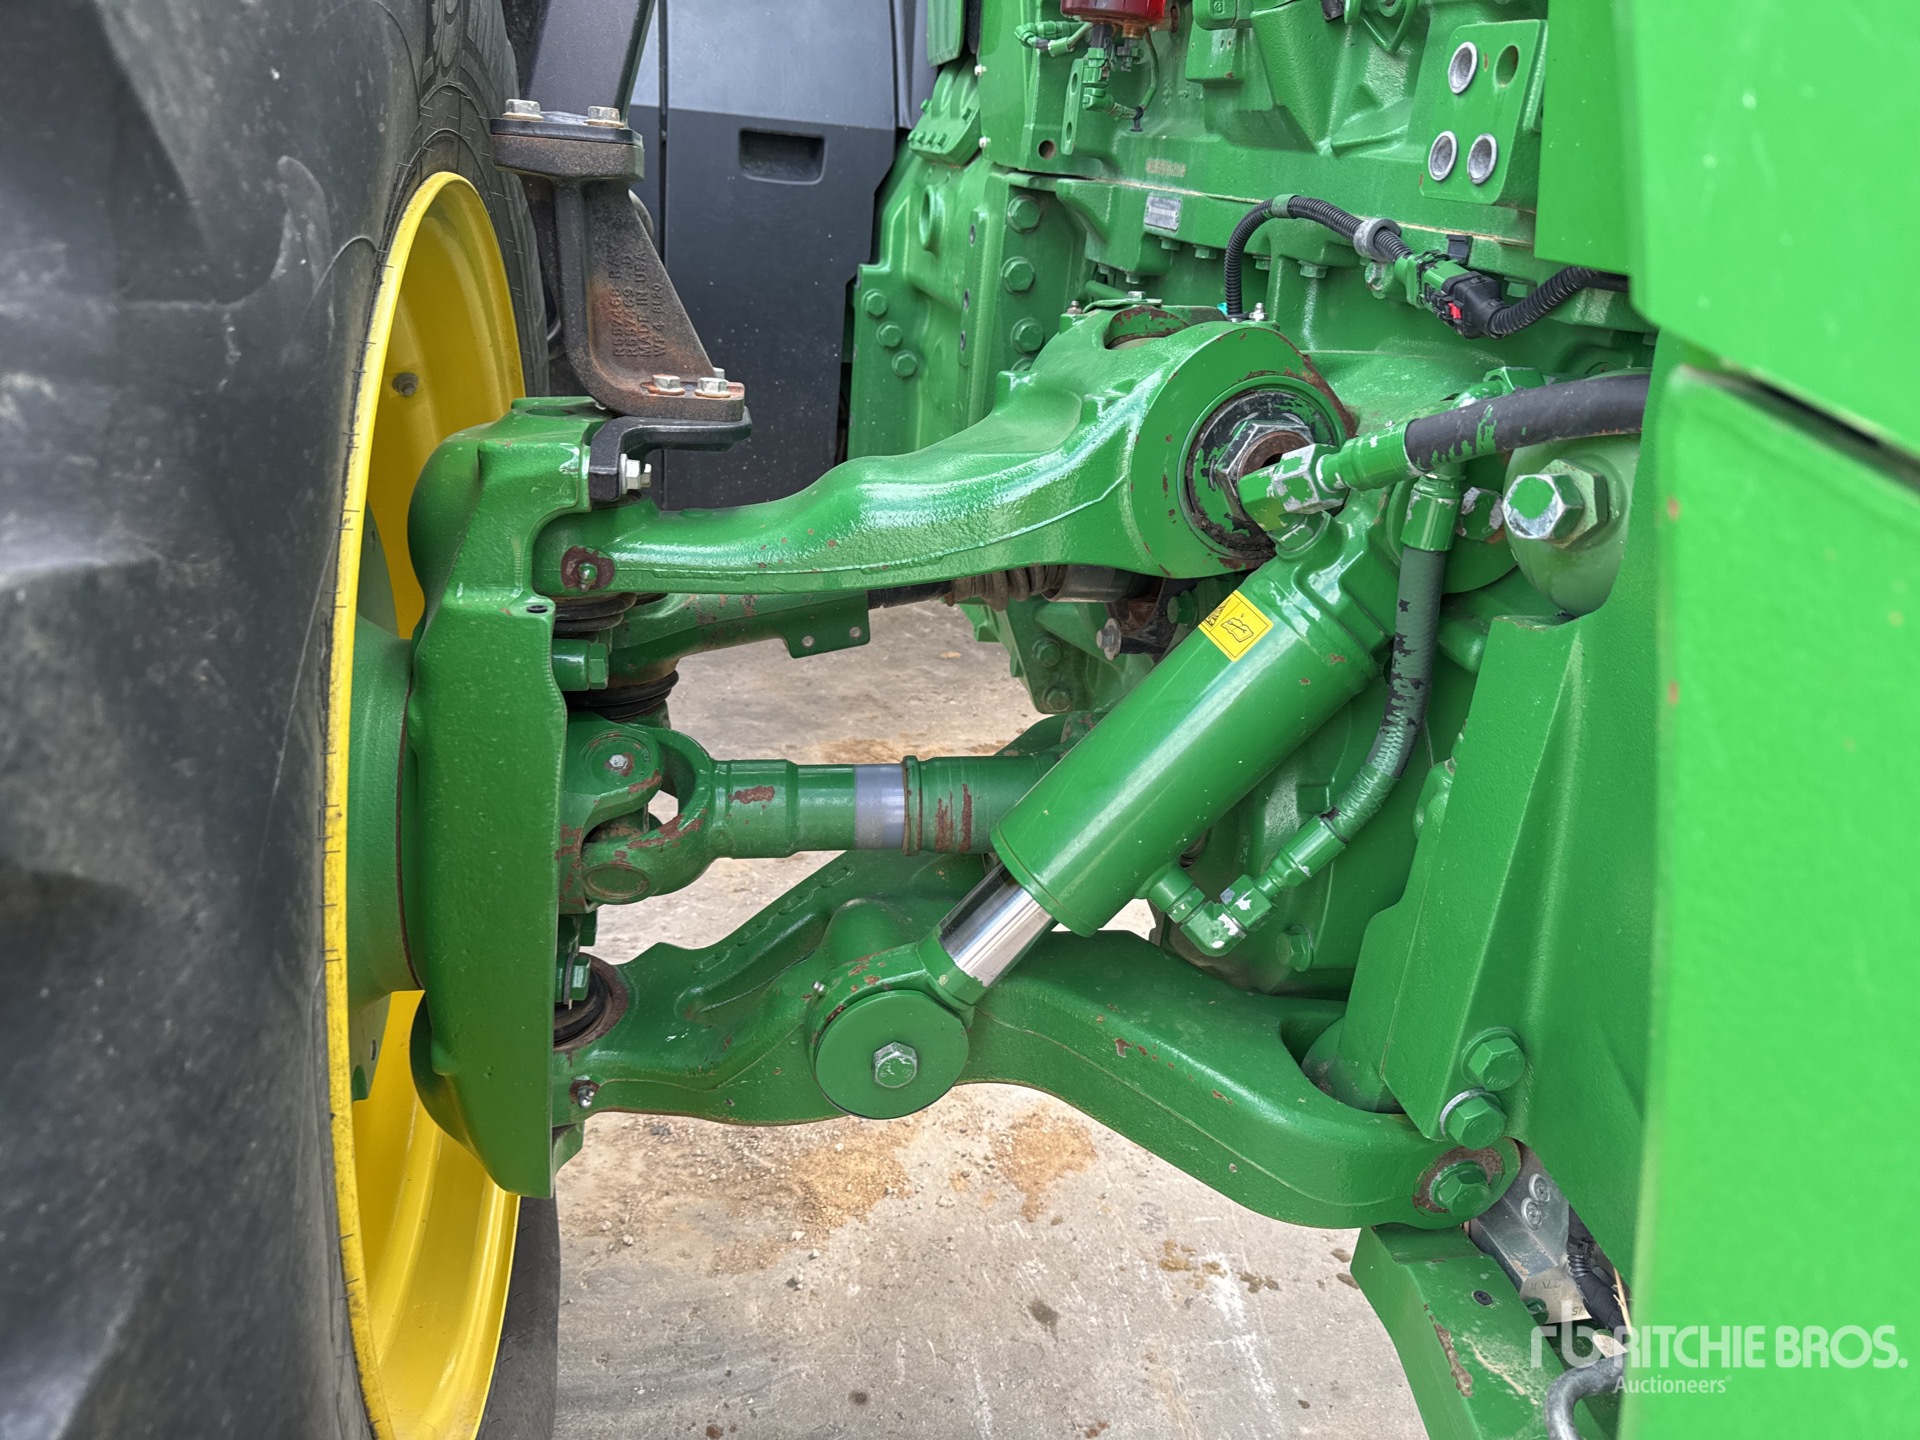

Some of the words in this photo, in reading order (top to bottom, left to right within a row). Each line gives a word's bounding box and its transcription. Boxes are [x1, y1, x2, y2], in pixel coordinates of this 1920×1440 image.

[634, 250, 647, 283] USA
[636, 290, 648, 306] IN
[637, 315, 651, 357] MADE
